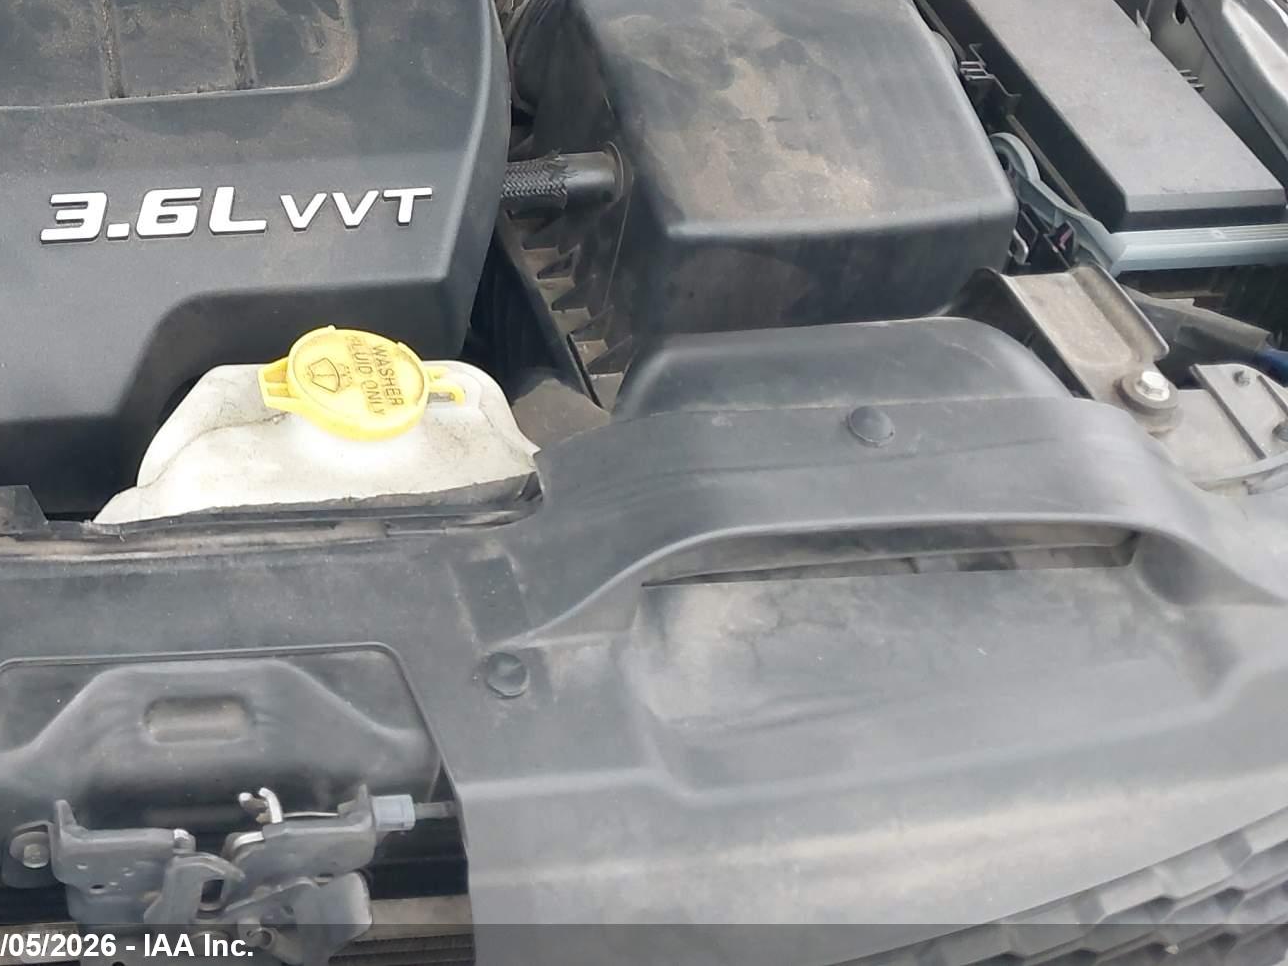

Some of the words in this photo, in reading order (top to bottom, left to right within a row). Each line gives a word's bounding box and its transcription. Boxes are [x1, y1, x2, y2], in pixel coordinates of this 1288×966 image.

[39, 186, 268, 243] 3.6L
[279, 187, 433, 233] VVT
[345, 335, 374, 377] FLUID
[361, 379, 387, 417] ONLY
[371, 343, 405, 407] WASHER
